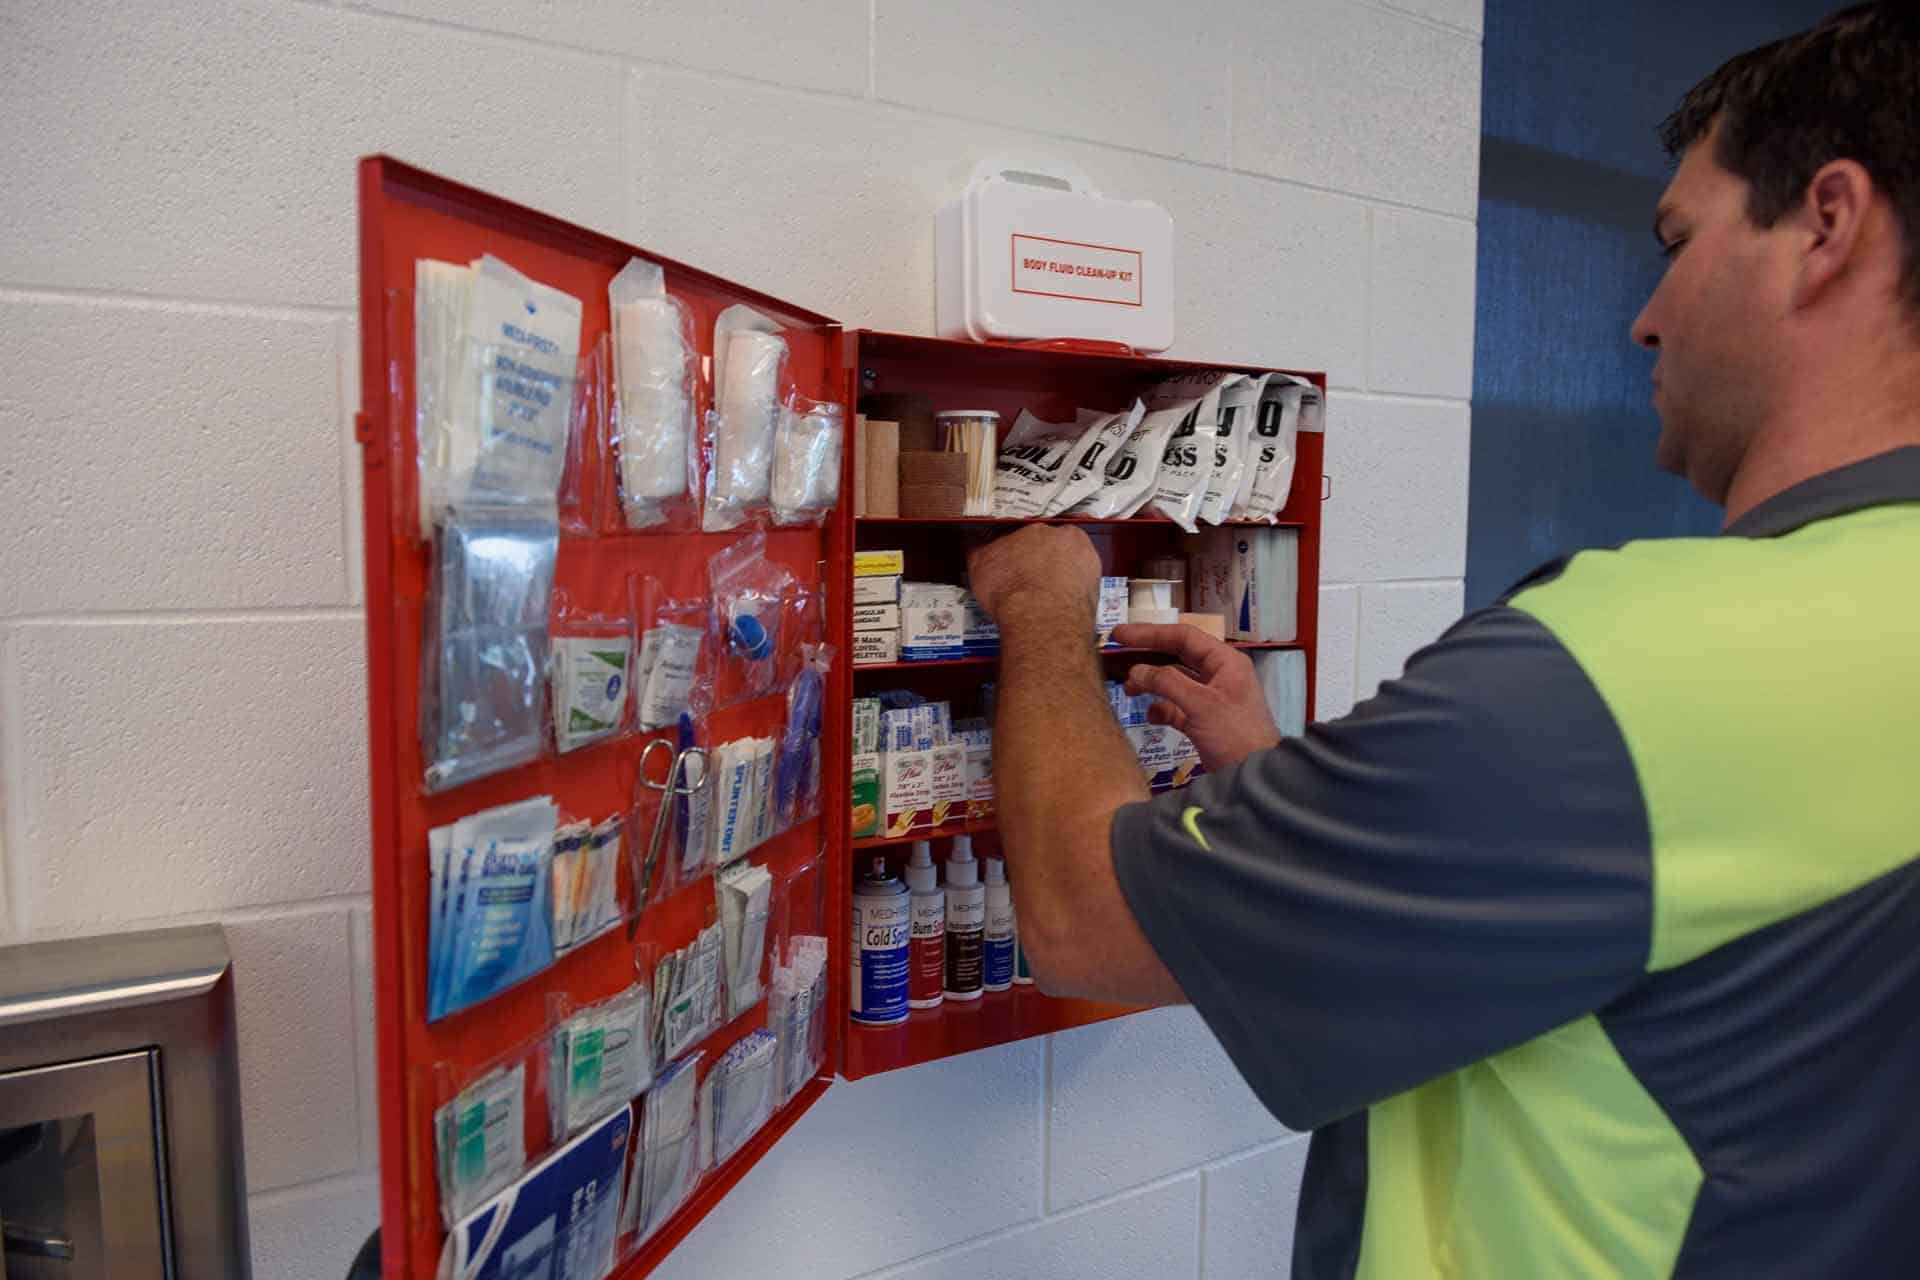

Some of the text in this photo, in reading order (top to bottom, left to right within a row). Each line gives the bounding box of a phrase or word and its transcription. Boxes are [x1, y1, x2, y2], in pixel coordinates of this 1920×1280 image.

[1023, 258, 1133, 282] BODY FLUID CLEAN-UP KIT
[912, 921, 932, 935] Burn
[866, 929, 890, 946] Cold
